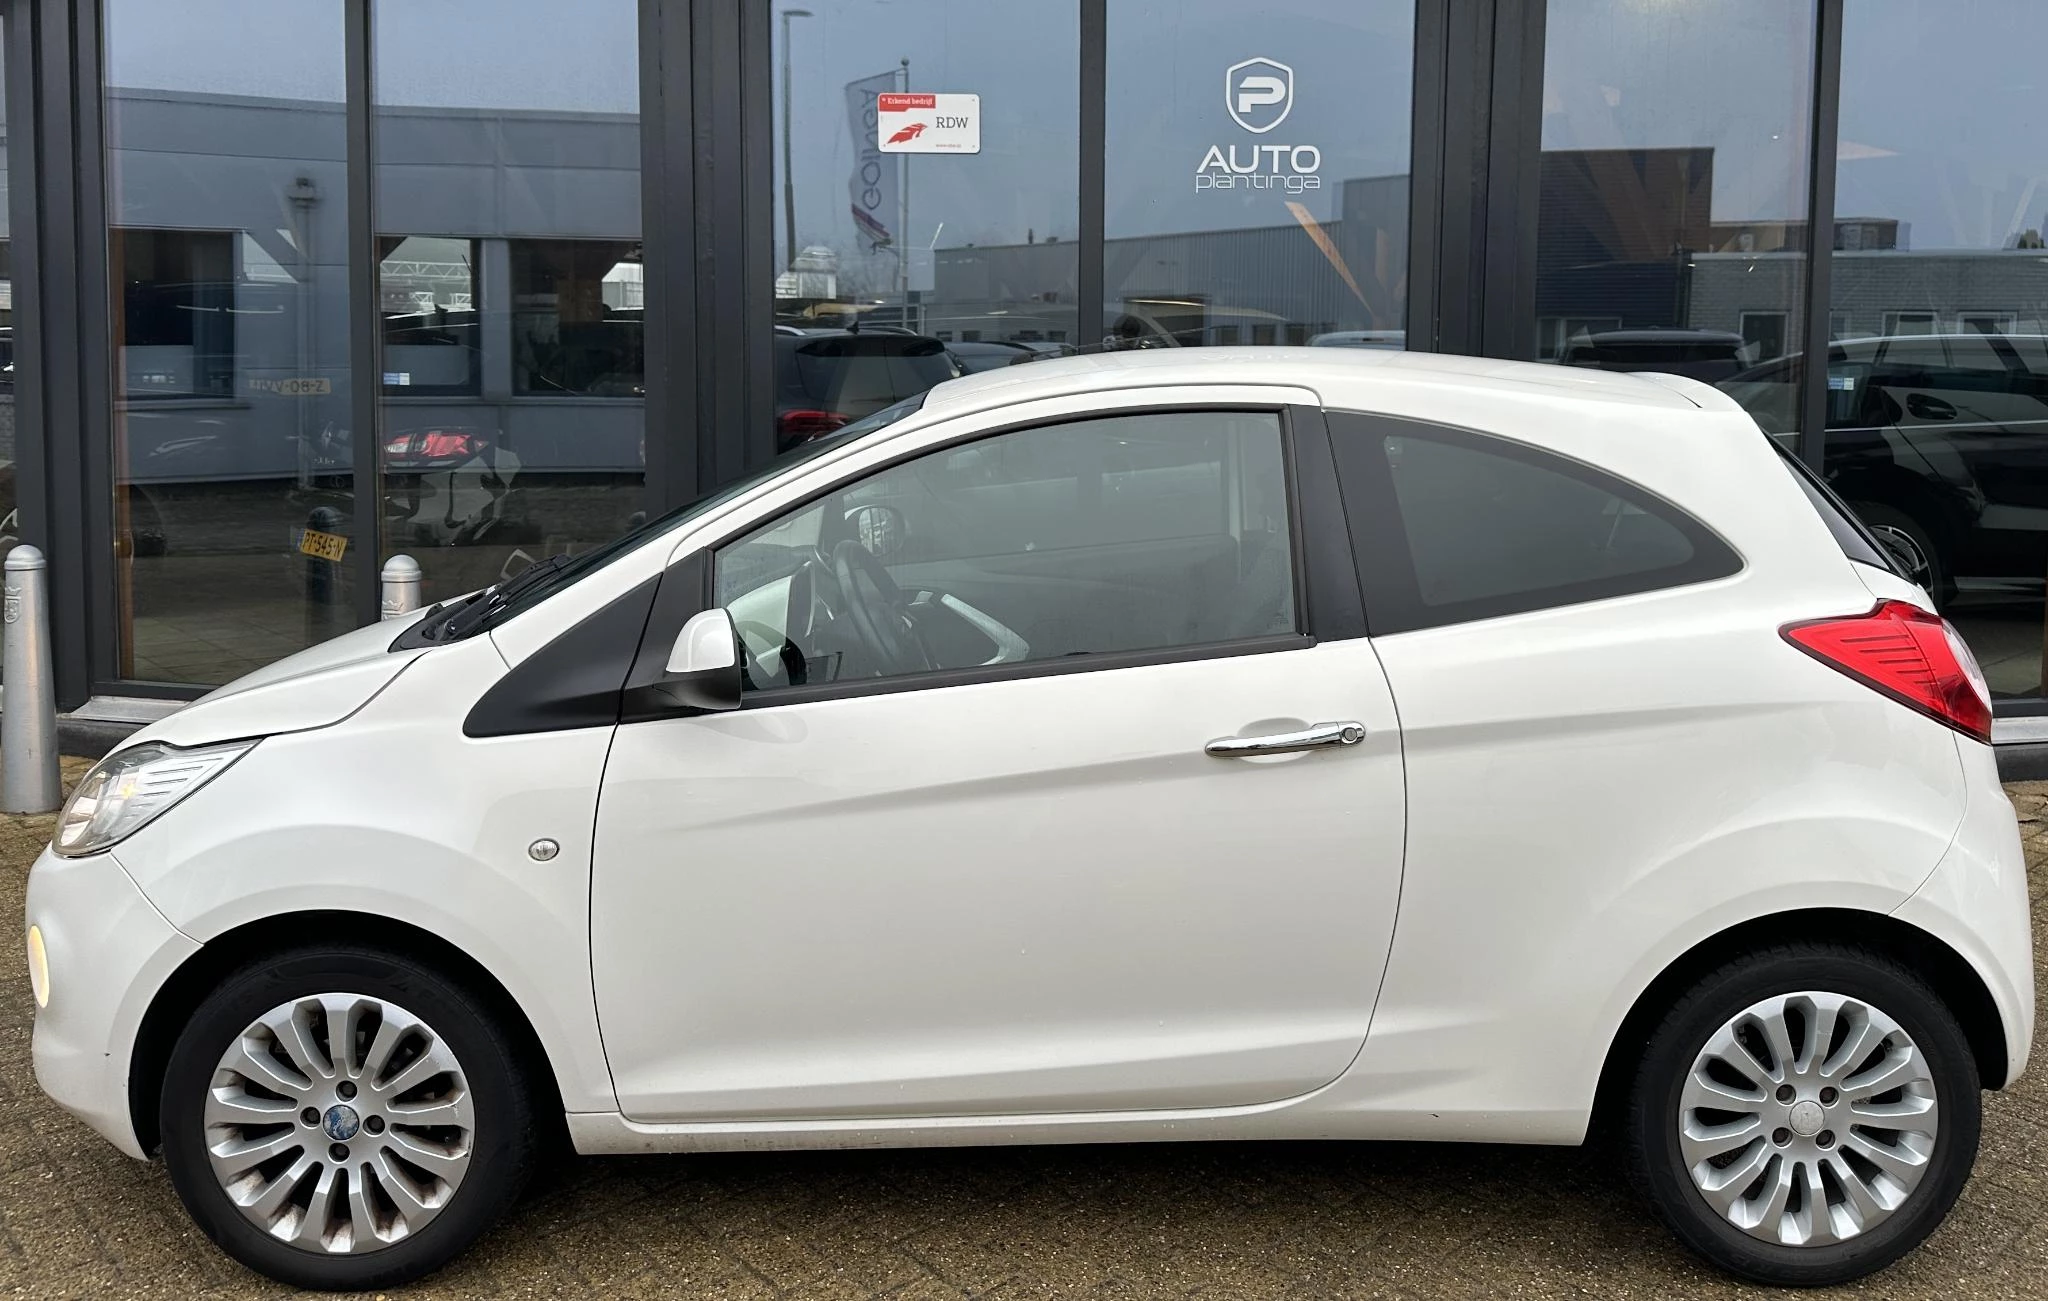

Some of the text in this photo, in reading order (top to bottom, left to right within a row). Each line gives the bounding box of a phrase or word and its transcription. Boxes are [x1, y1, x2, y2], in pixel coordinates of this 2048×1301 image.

[1238, 76, 1286, 113] P
[935, 116, 969, 129] RDW
[1196, 144, 1321, 174] AUTO
[1195, 172, 1321, 194] plantinga
